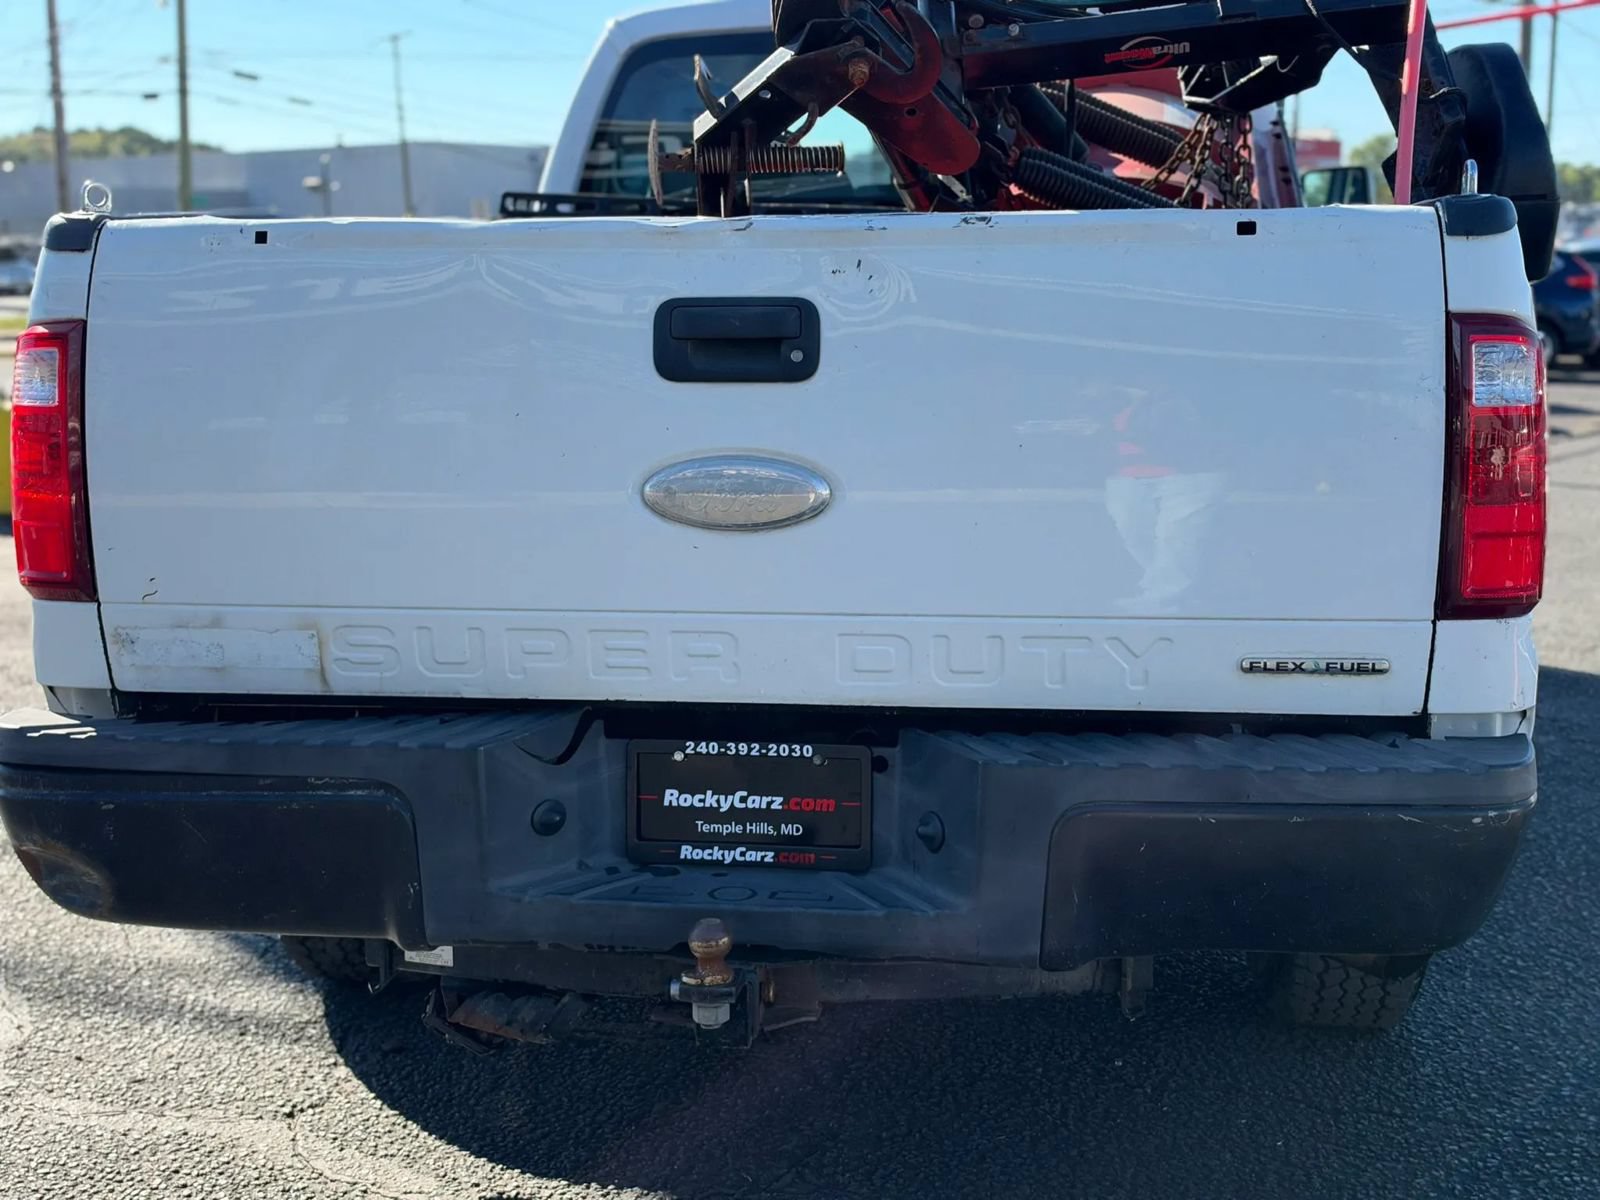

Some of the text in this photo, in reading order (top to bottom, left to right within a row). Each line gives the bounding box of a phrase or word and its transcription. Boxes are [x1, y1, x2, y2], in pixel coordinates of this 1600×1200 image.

[330, 624, 1175, 691] SUPER DUTY
[1249, 660, 1384, 673] FLEX FUEL
[684, 740, 814, 758] 240-392-2030
[663, 788, 836, 812] RockyCarz.com
[695, 820, 803, 837] Temple Hills, MD
[679, 845, 816, 864] RockyCarz.com
